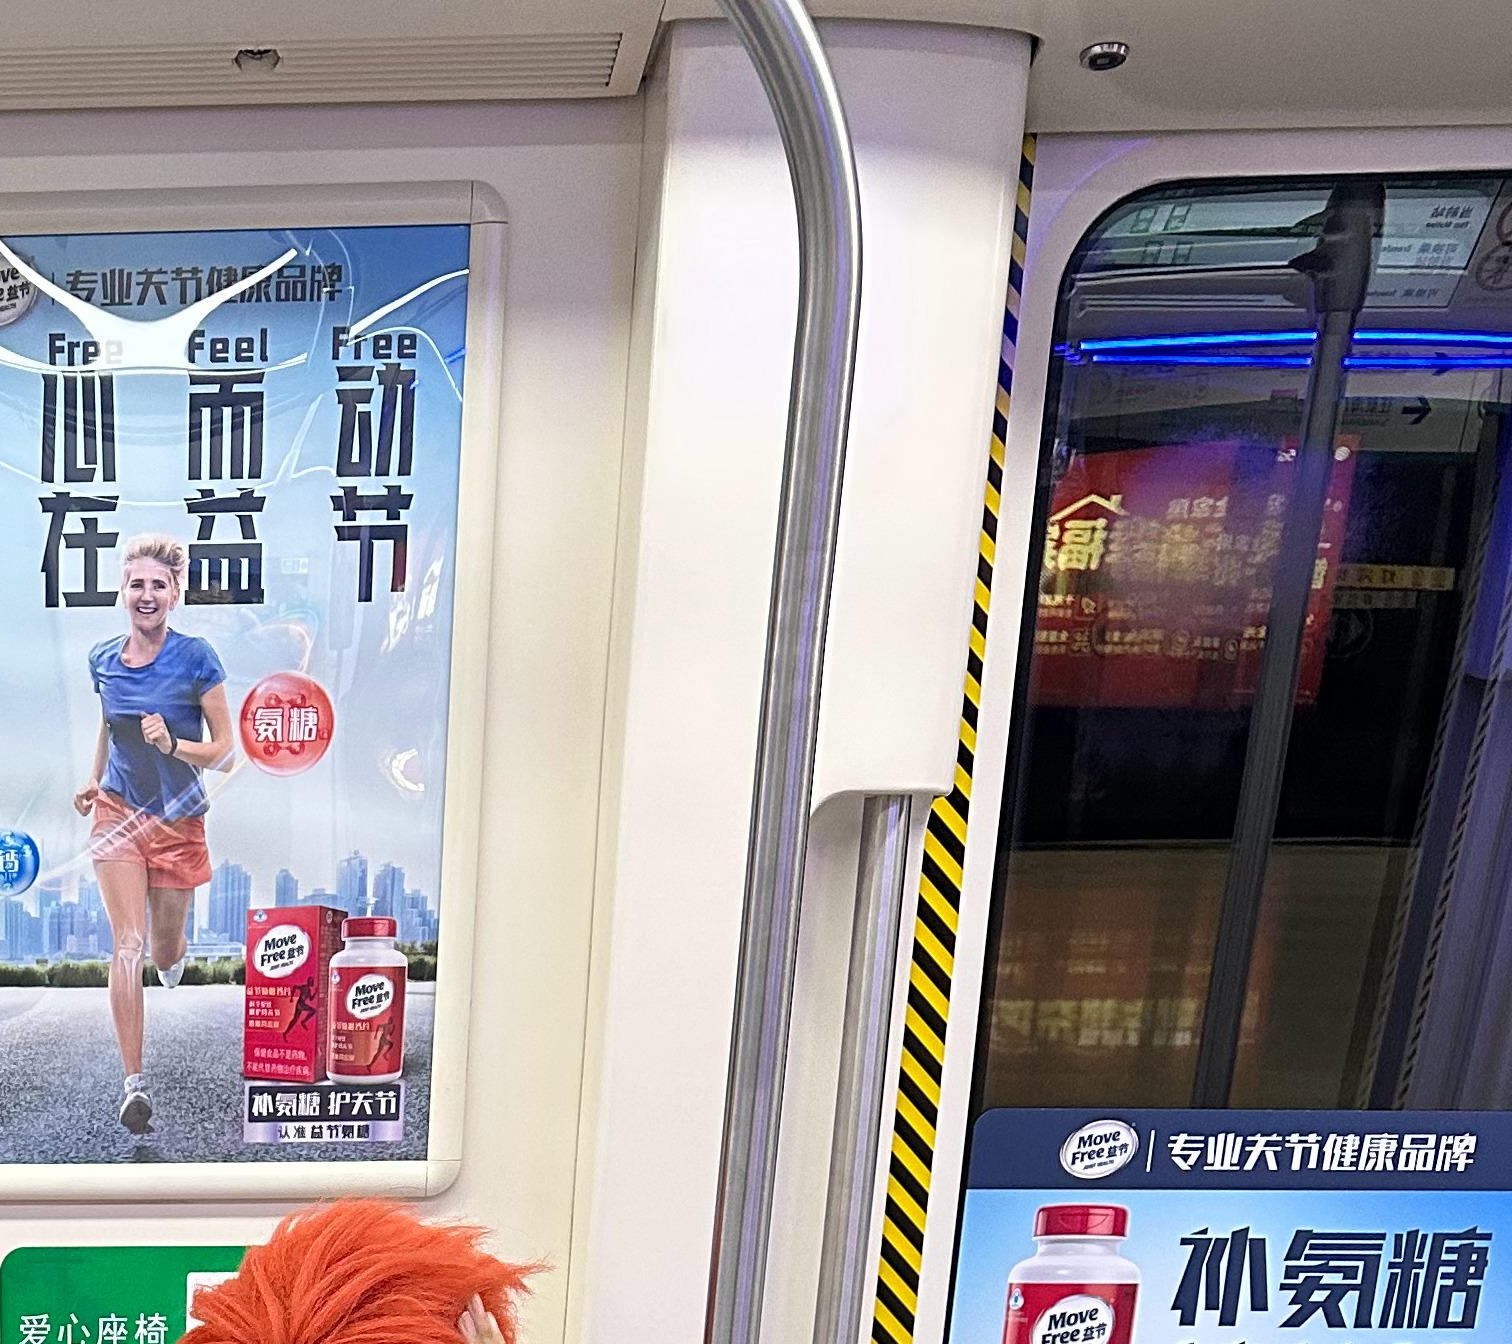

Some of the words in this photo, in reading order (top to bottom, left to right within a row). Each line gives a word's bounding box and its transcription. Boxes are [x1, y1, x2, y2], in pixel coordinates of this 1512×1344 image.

[66, 261, 343, 307] 专业关节健康品牌
[188, 328, 269, 364] Feel
[332, 326, 417, 361] Free
[254, 706, 318, 742] 氨糖
[264, 934, 297, 953] Move
[260, 950, 286, 967] Free
[355, 981, 385, 997] Move
[352, 995, 375, 1010] Free
[251, 1092, 321, 1117] 补氨糖
[327, 1090, 398, 1116] 护关节
[1077, 1130, 1121, 1150] Move
[1071, 1147, 1105, 1166] Free
[1167, 1131, 1478, 1174] 专业关节健康品牌
[1170, 1225, 1493, 1329] 补氨糖
[1047, 1307, 1099, 1332] Move
[1082, 1322, 1107, 1342] 益节
